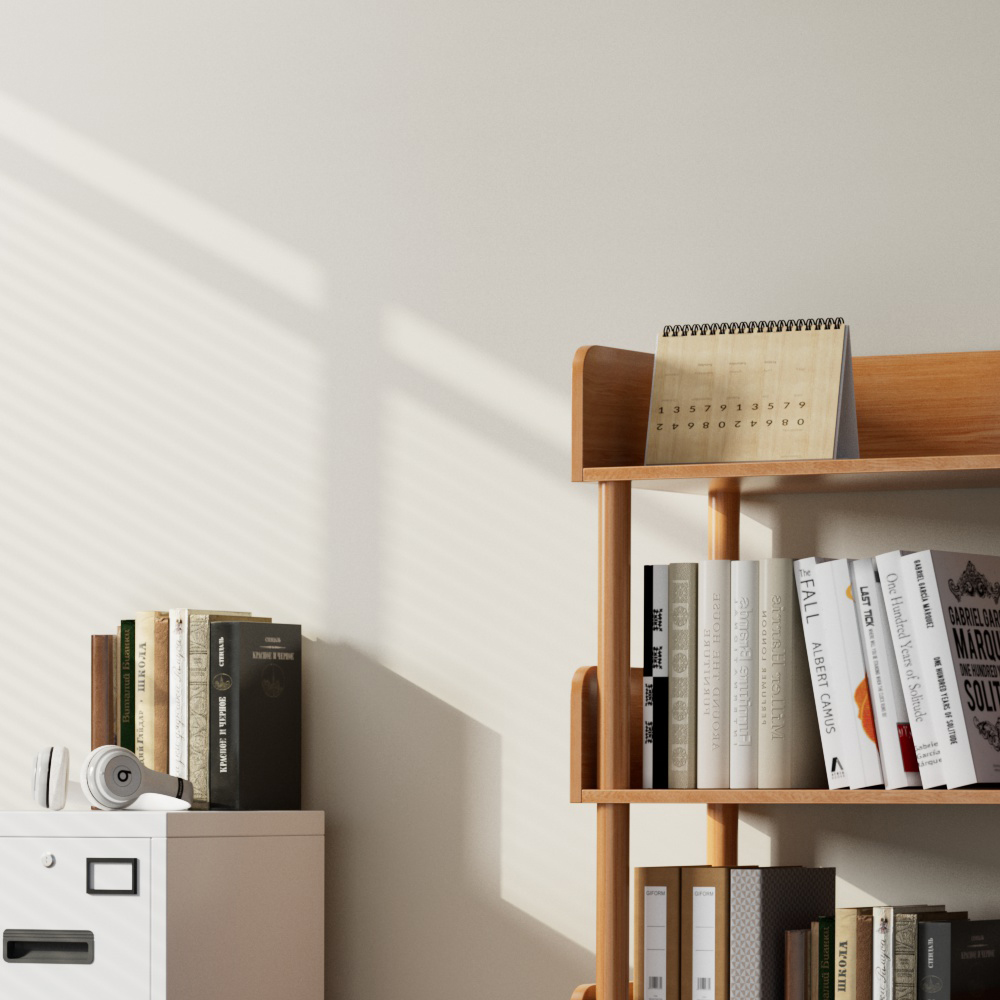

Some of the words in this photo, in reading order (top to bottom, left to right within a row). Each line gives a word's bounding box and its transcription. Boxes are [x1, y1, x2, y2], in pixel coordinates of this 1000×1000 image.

[799, 567, 811, 579] The
[913, 559, 924, 582] GABRIEL
[859, 586, 871, 607] LAST
[886, 573, 898, 595] One
[918, 582, 929, 602] GARCÍA
[801, 579, 819, 624] FALL
[863, 609, 875, 627] TICK
[891, 597, 910, 640] Hundred
[922, 603, 935, 629] MÁRQUEZ
[948, 606, 984, 628] GABRIEL
[812, 642, 829, 688] ALBERT
[900, 641, 914, 667] Years
[933, 656, 941, 667] ONE
[138, 643, 147, 692] ШКОЛА
[906, 669, 919, 680] of
[935, 668, 947, 692] HUNDRED
[959, 664, 972, 678] ONE
[972, 664, 996, 680] HUNDRED
[123, 672, 131, 723] Виталий
[908, 683, 924, 723] Solitude
[940, 692, 951, 711] YEARS
[218, 696, 227, 728] ЧЕРНОЕ
[820, 693, 836, 734] CAMUS
[944, 711, 953, 719] OF
[946, 720, 958, 745] SOLITUDE
[219, 737, 228, 773] КРАСНОЕ
[820, 926, 830, 969] Бианки
[838, 941, 848, 992] ШКОЛА
